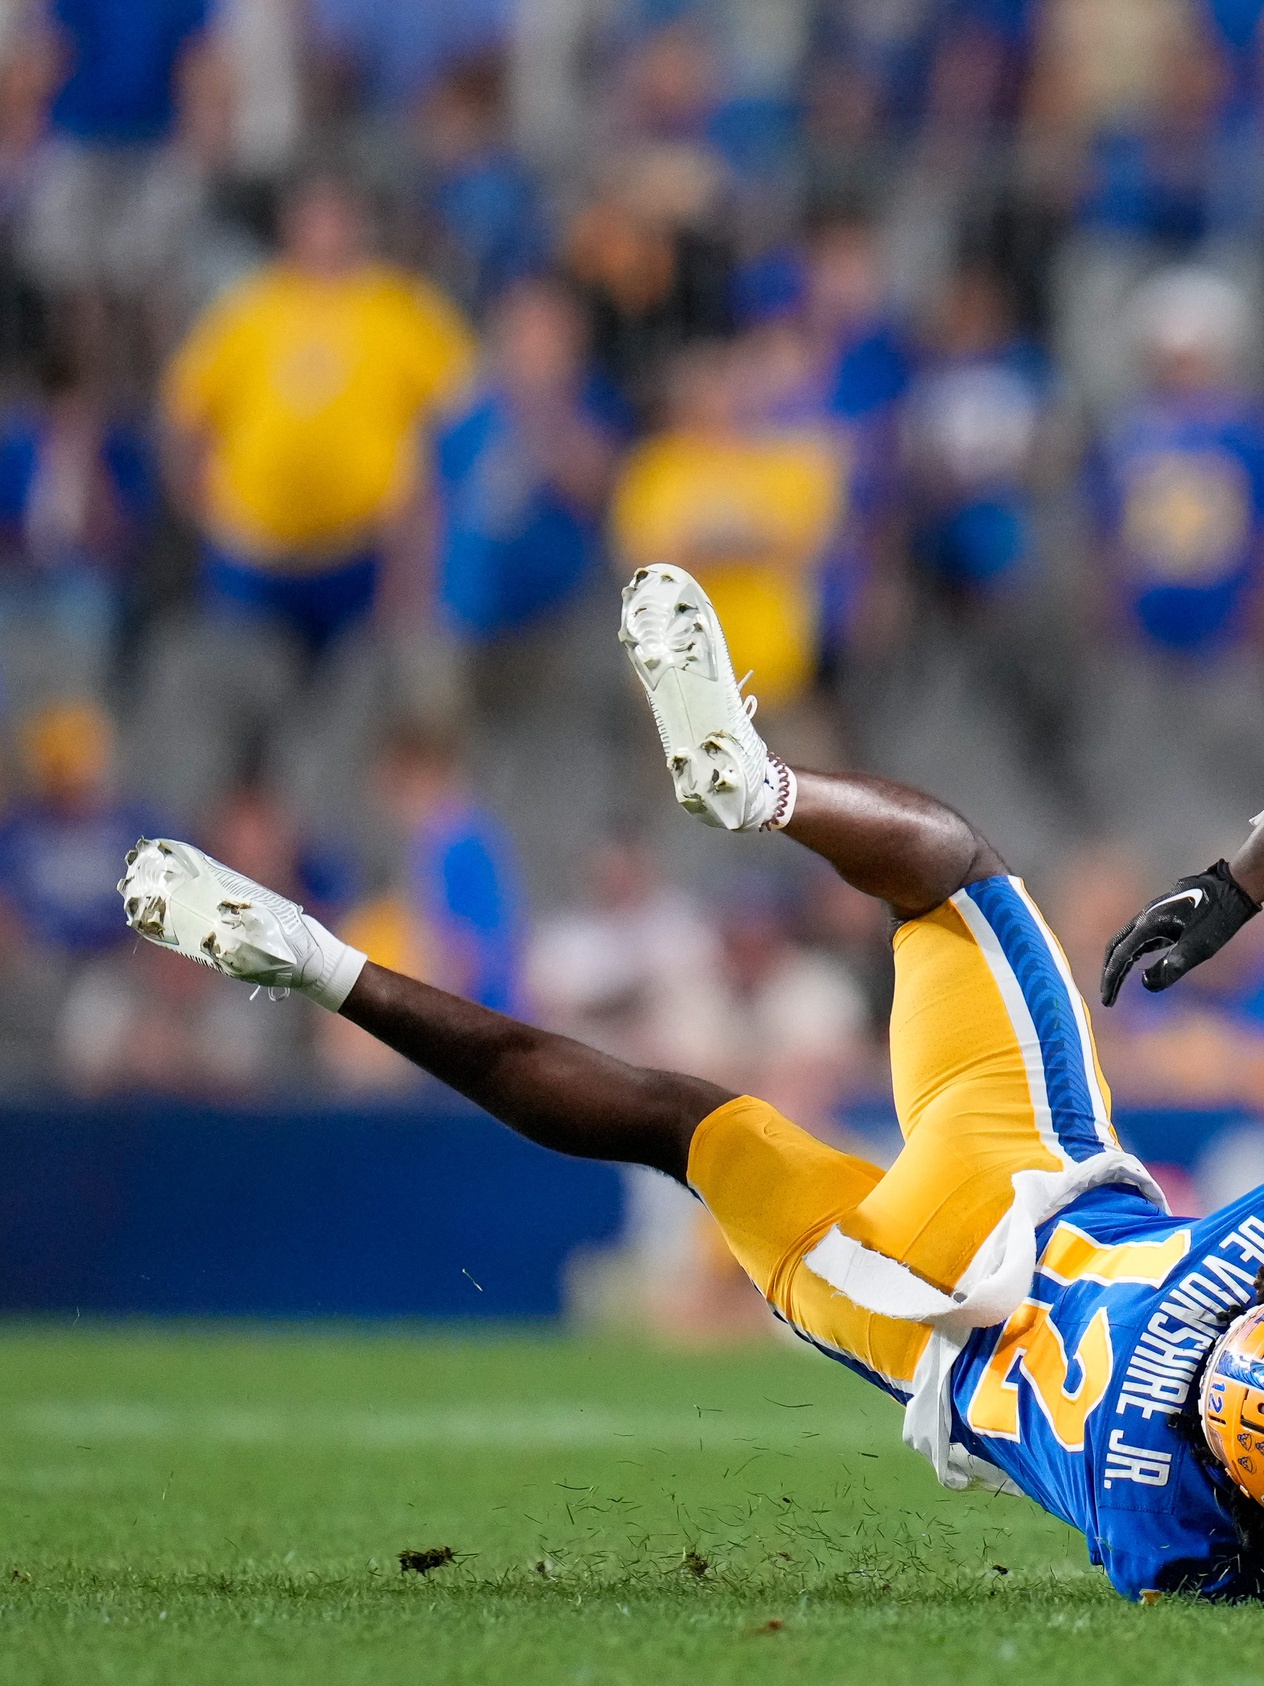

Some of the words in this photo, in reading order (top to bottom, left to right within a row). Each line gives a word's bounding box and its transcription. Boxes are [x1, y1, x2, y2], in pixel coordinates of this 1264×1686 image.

[966, 1220, 1192, 1452] 12
[1208, 1382, 1227, 1415] 12
[1103, 1429, 1173, 1490] JR.
